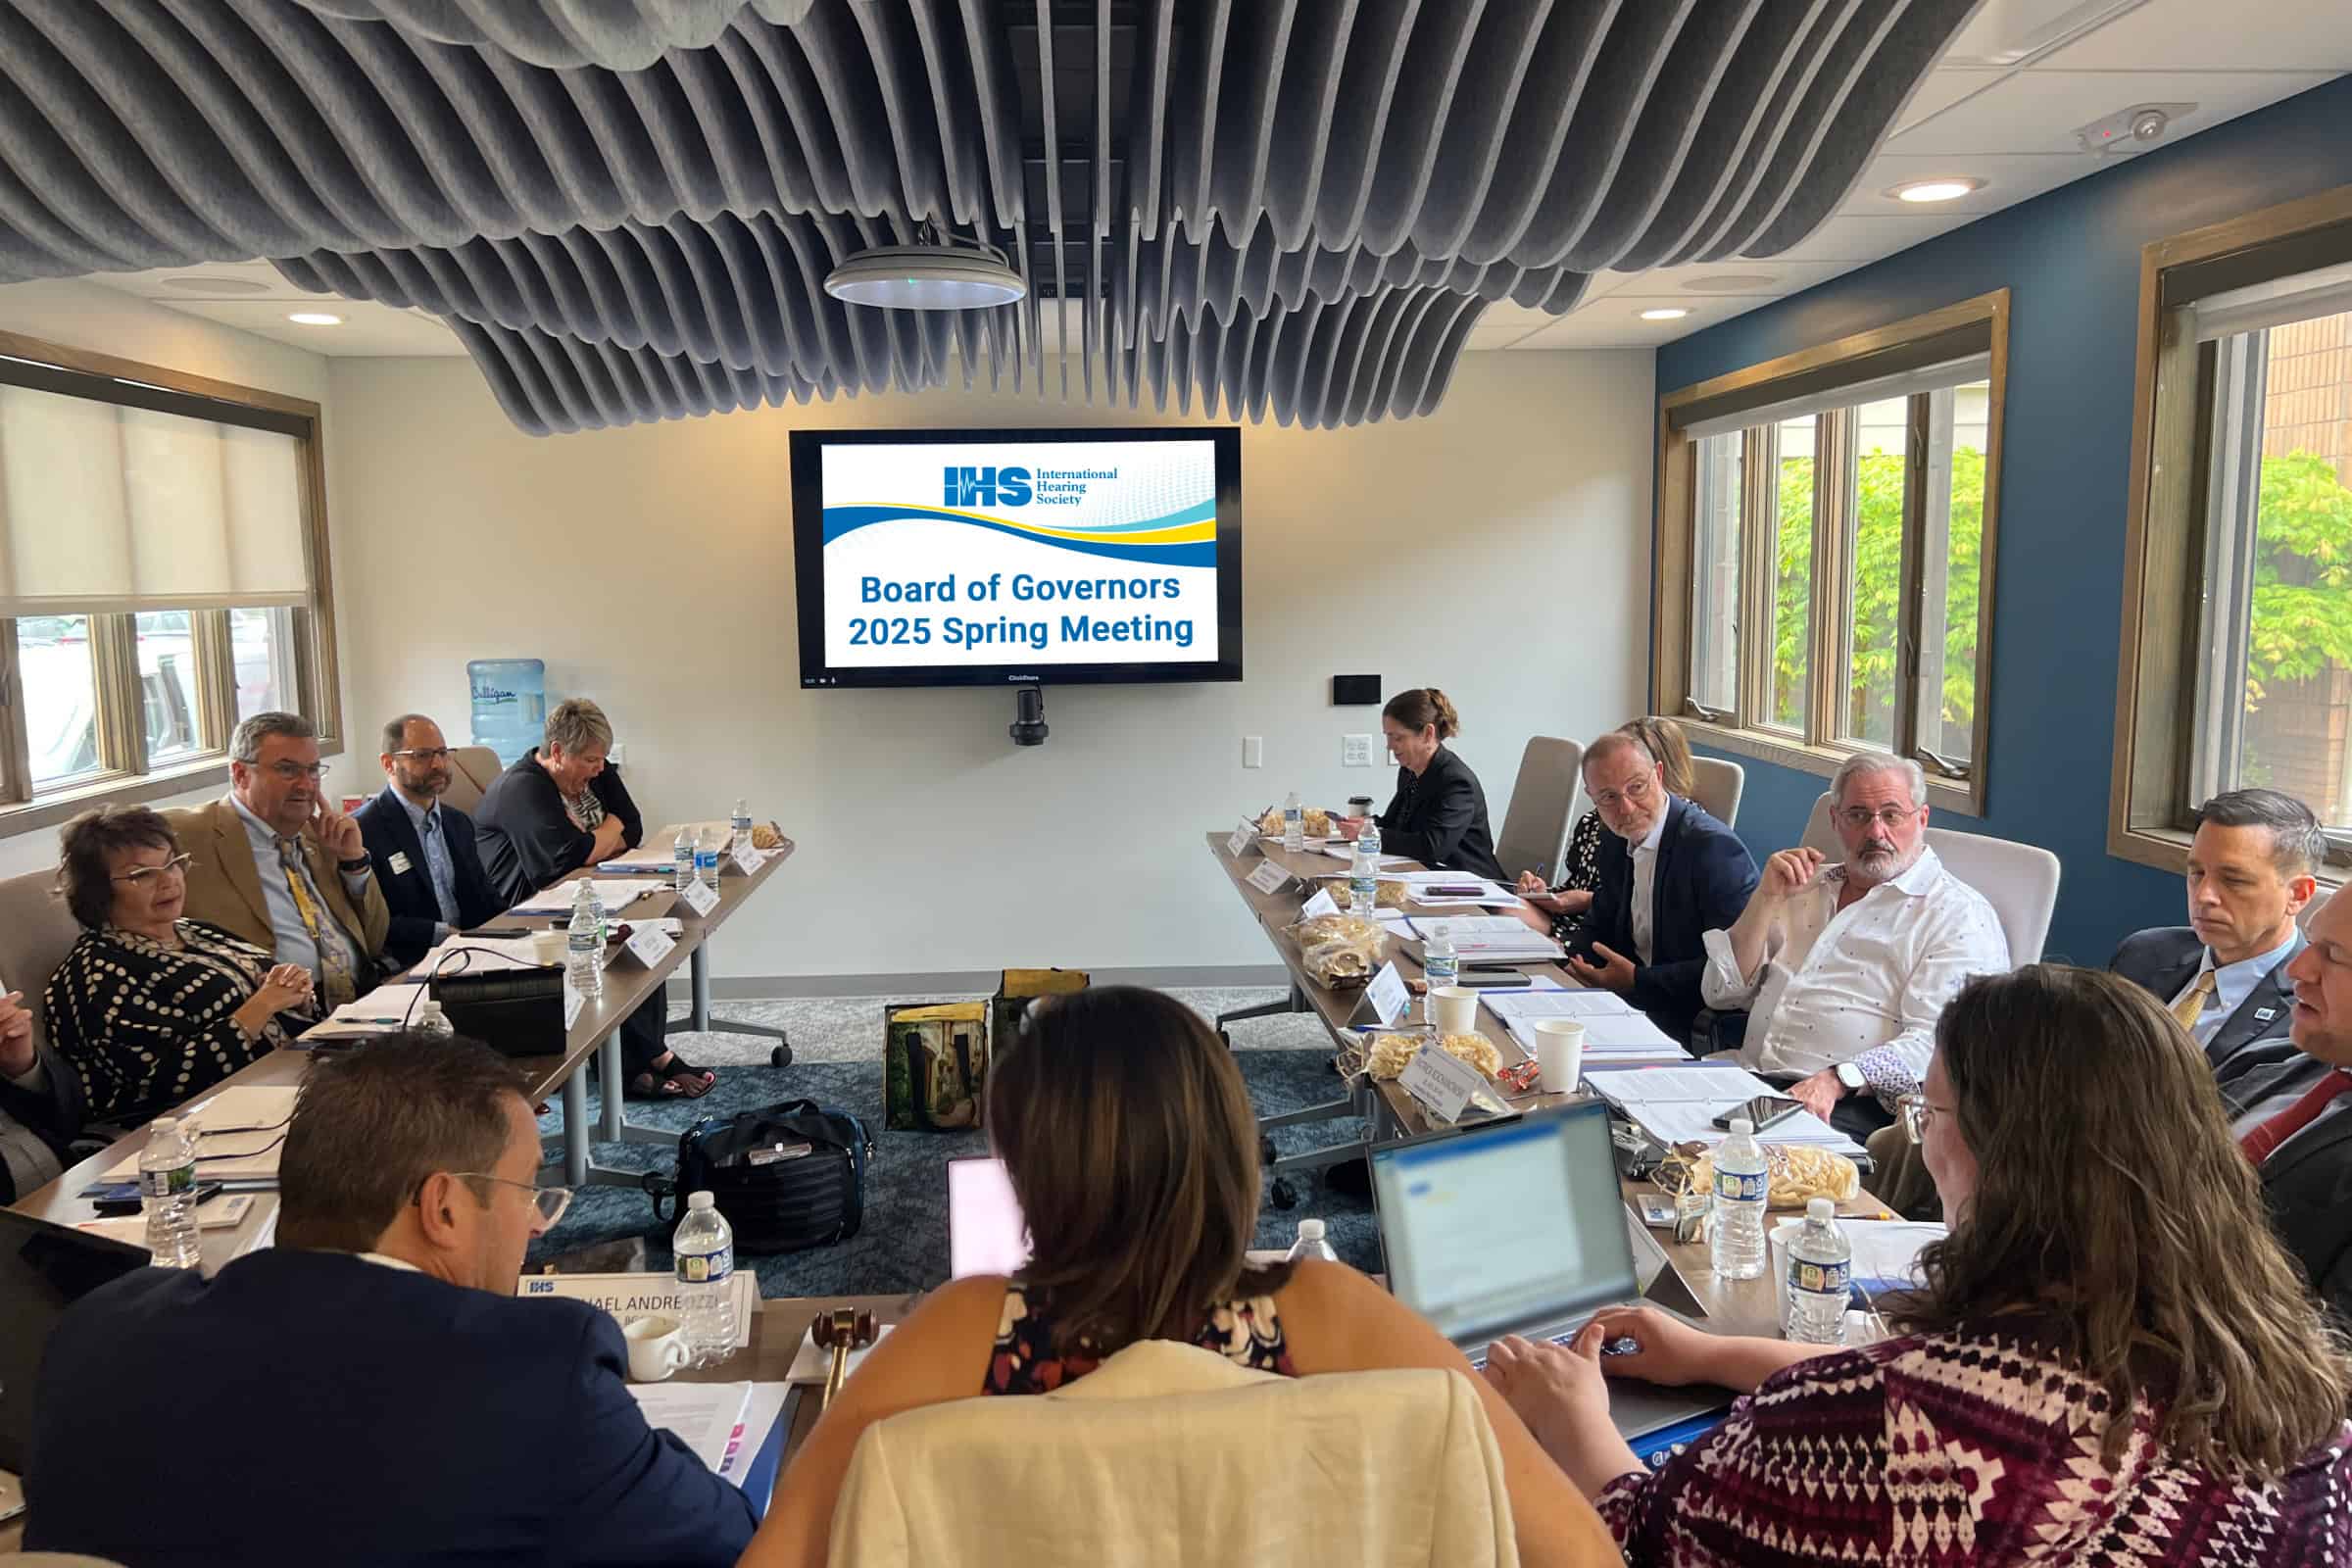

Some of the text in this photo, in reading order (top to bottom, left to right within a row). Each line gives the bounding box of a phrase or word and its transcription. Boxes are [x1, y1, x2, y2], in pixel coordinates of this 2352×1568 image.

[1036, 467, 1118, 479] International
[944, 466, 1033, 507] IHS
[1036, 480, 1087, 494] Hearing
[1036, 493, 1082, 507] Society
[861, 573, 1180, 603] Board of Governors
[849, 614, 1193, 651] 2025 Spring Meeting
[529, 1281, 555, 1294] IHS
